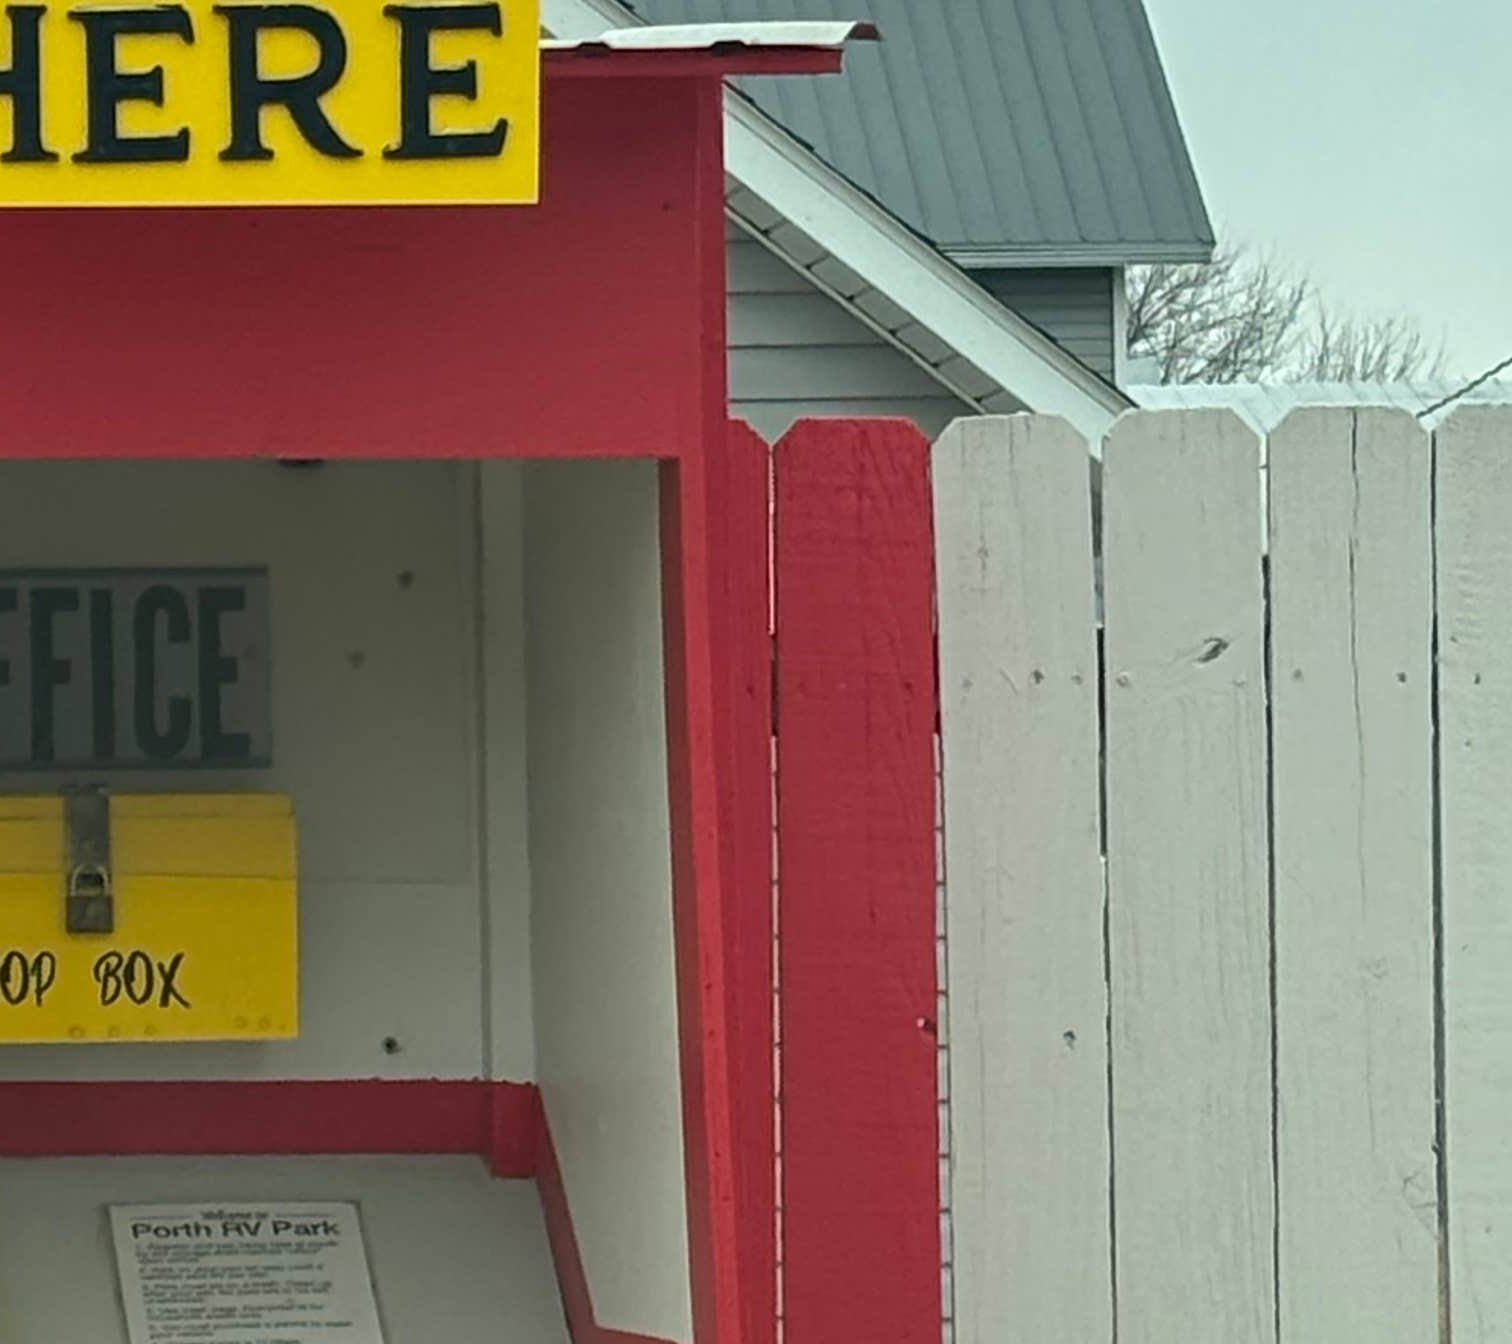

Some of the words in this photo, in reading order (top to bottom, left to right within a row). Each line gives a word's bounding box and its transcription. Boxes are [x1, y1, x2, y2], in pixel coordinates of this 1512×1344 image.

[94, 949, 191, 1008] BOX
[131, 1221, 212, 1239] Porth
[222, 1221, 262, 1237] RV
[272, 1219, 340, 1236] Park
